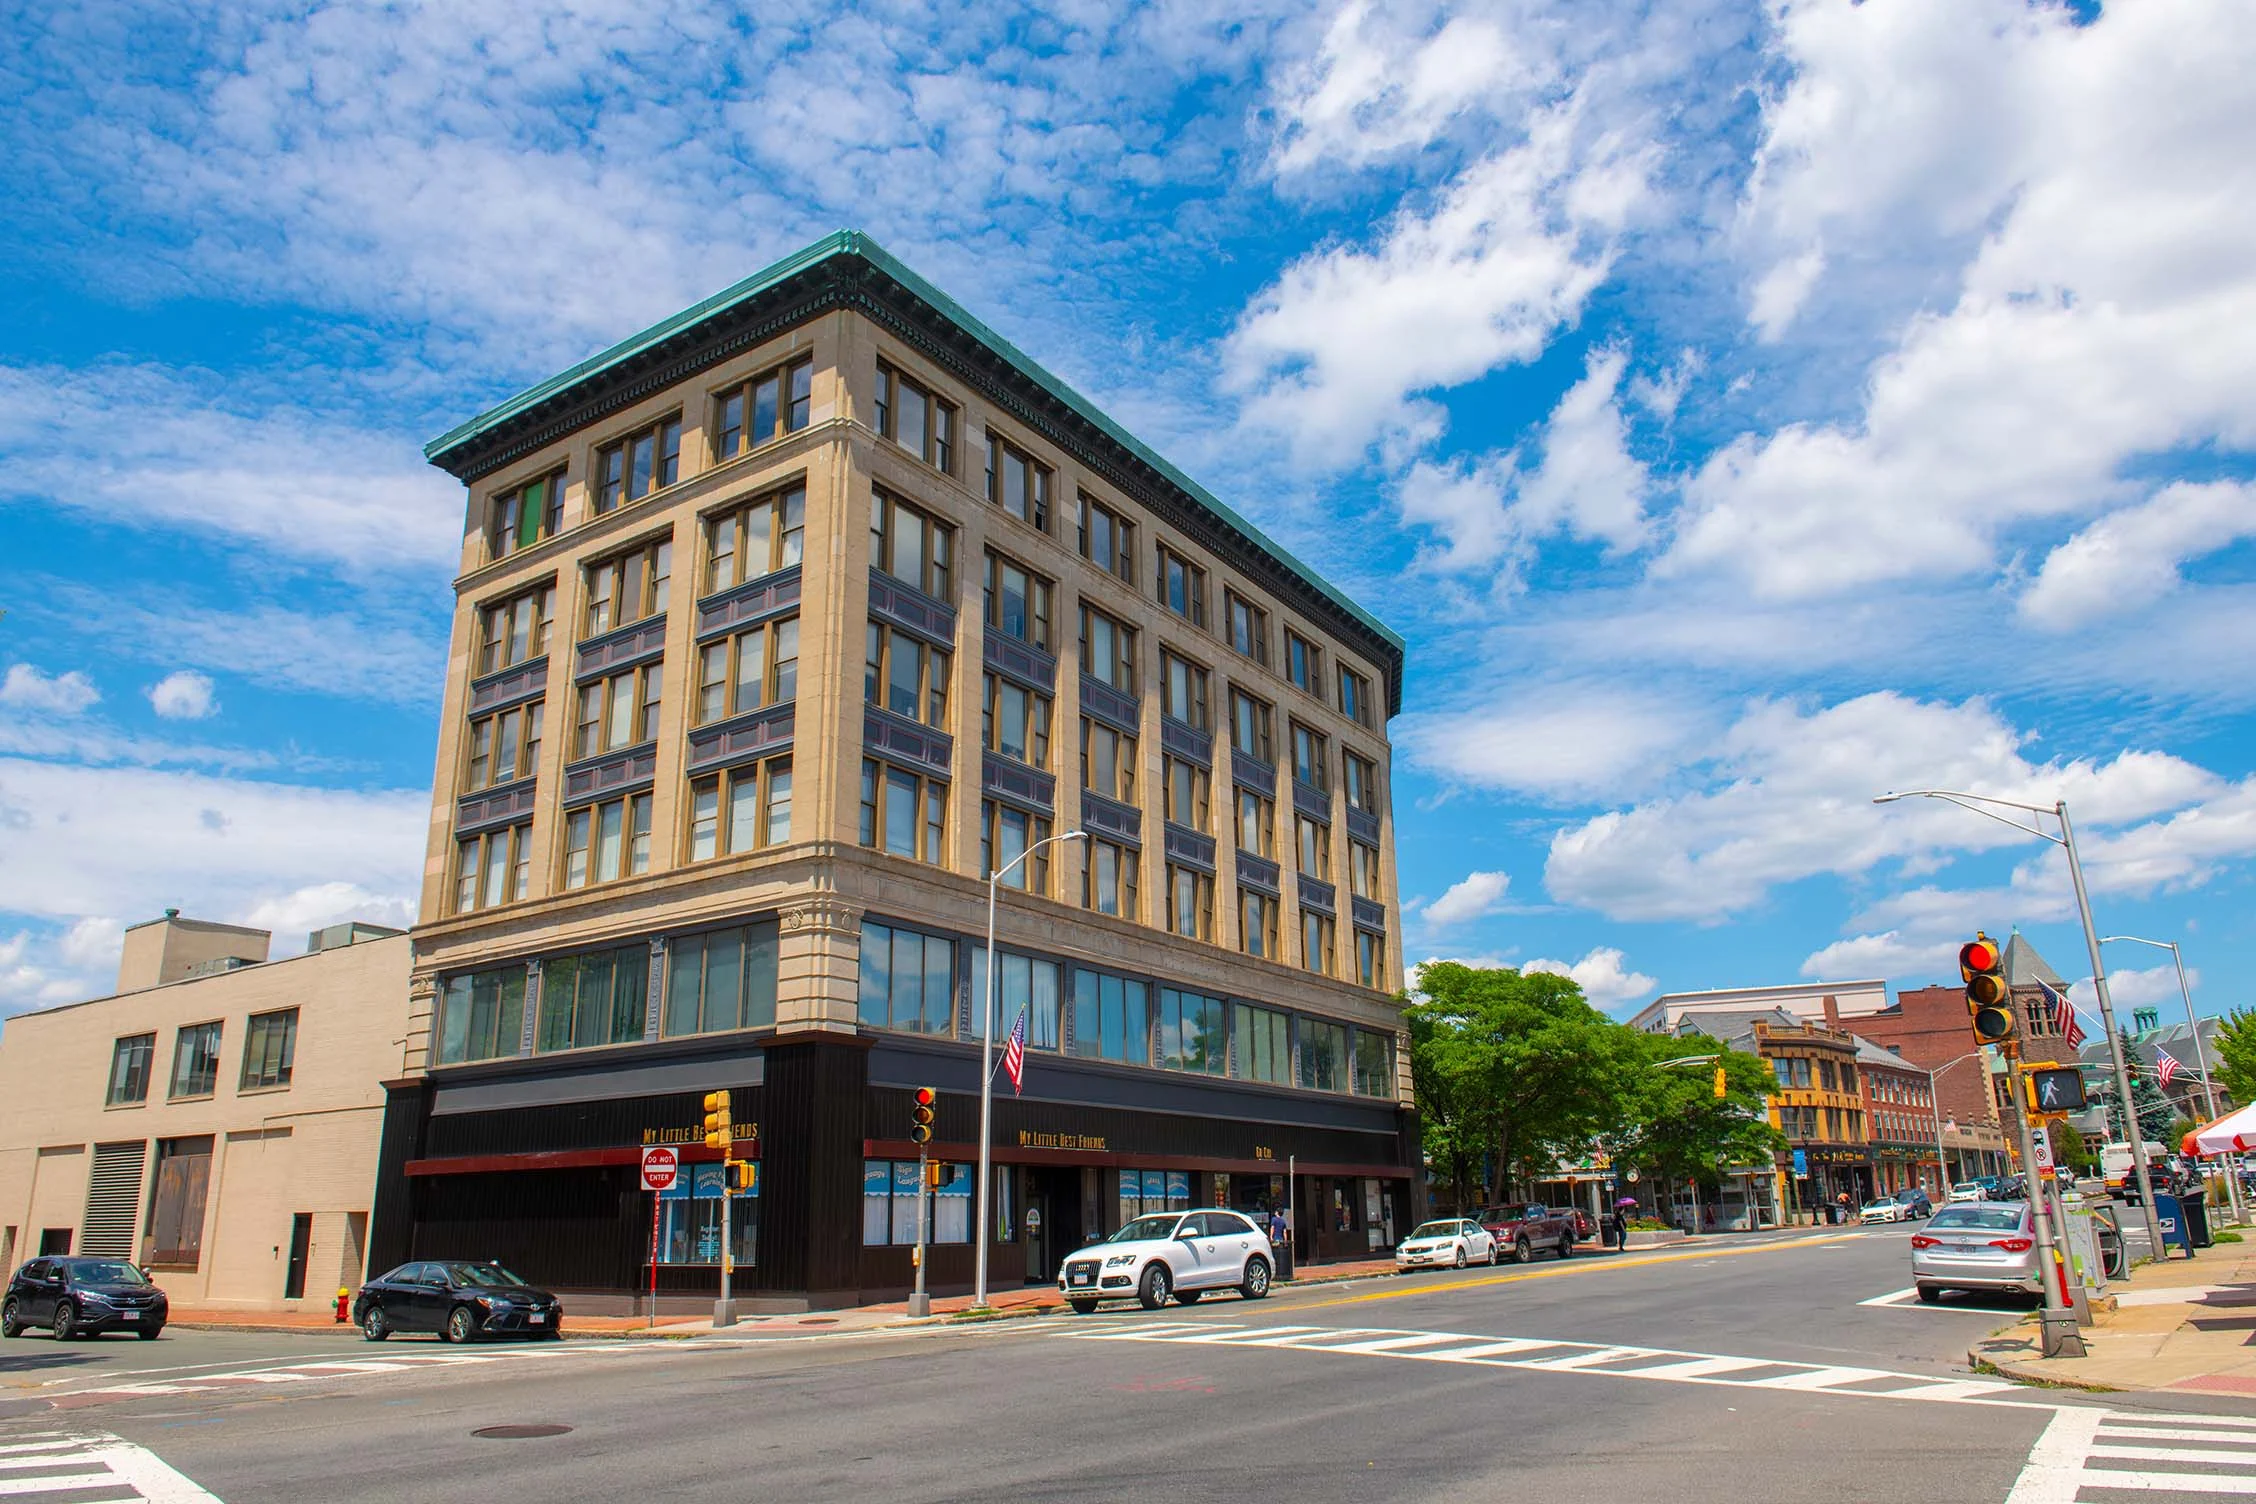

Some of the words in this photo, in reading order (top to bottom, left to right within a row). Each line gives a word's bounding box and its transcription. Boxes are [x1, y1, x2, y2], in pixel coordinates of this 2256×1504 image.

[643, 1127, 657, 1144] MY
[660, 1126, 690, 1143] LITTLE
[693, 1124, 705, 1141] BE
[1019, 1129, 1031, 1145] MY
[1034, 1131, 1057, 1147] LITTLE
[1059, 1133, 1077, 1148] BEST
